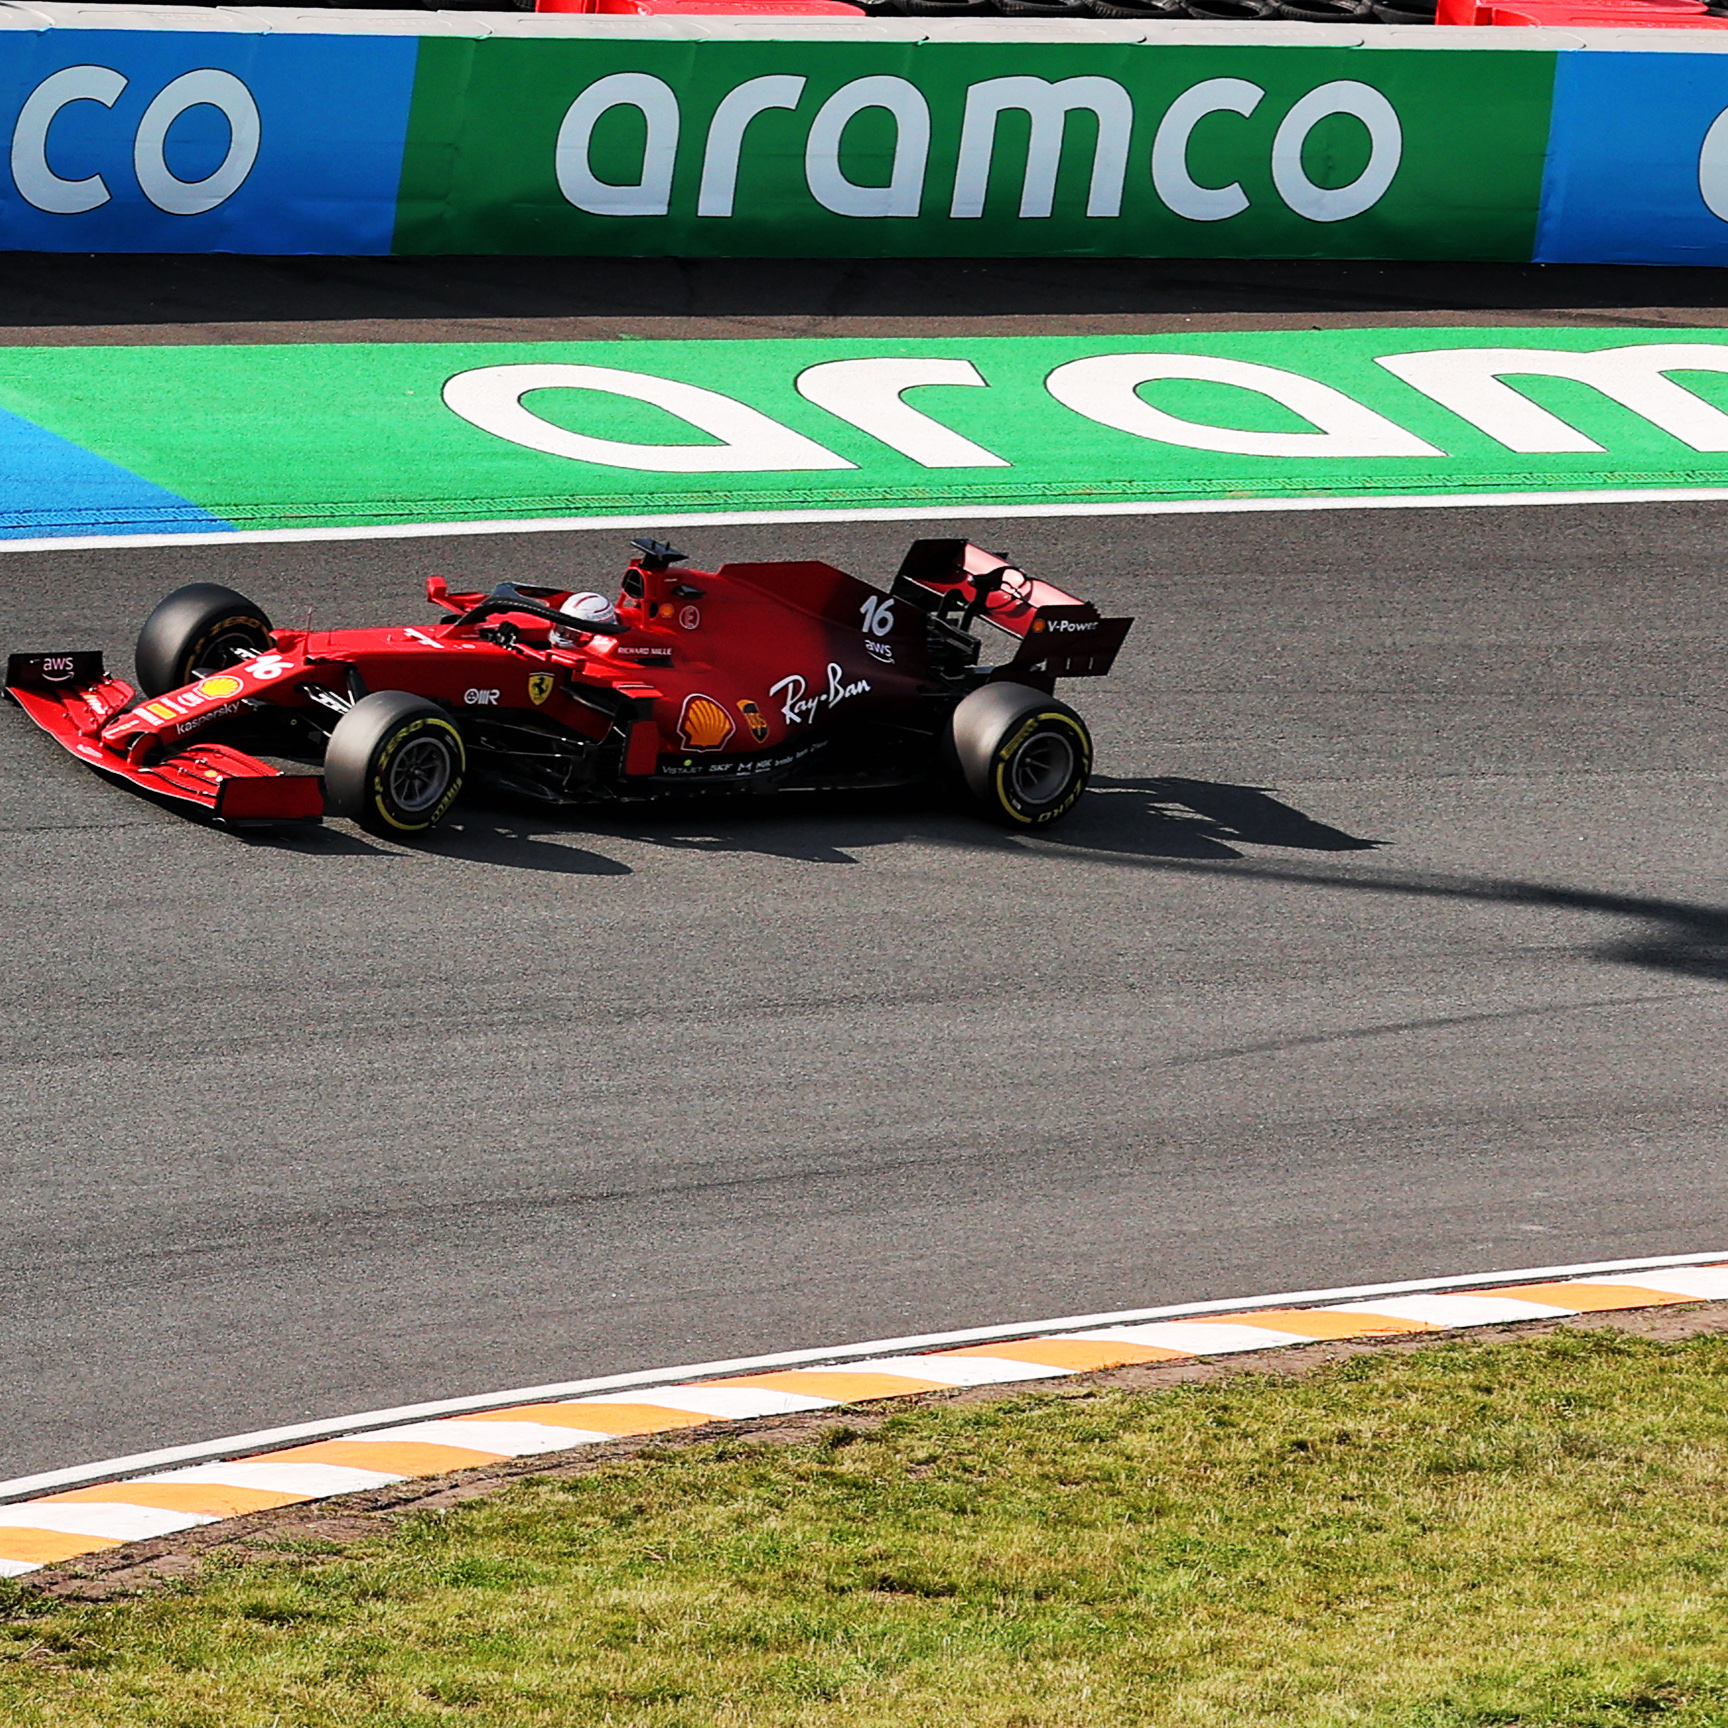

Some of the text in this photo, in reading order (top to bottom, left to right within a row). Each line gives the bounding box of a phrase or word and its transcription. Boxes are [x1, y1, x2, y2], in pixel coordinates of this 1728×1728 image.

[555, 72, 1403, 222] aramco
[859, 595, 895, 637] 16
[1047, 619, 1099, 633] V-Power
[617, 647, 672, 656] RICHARD MILLE
[865, 640, 892, 658] aws
[43, 655, 75, 672] aws
[245, 654, 294, 681] 16
[176, 700, 242, 735] kaspersky
